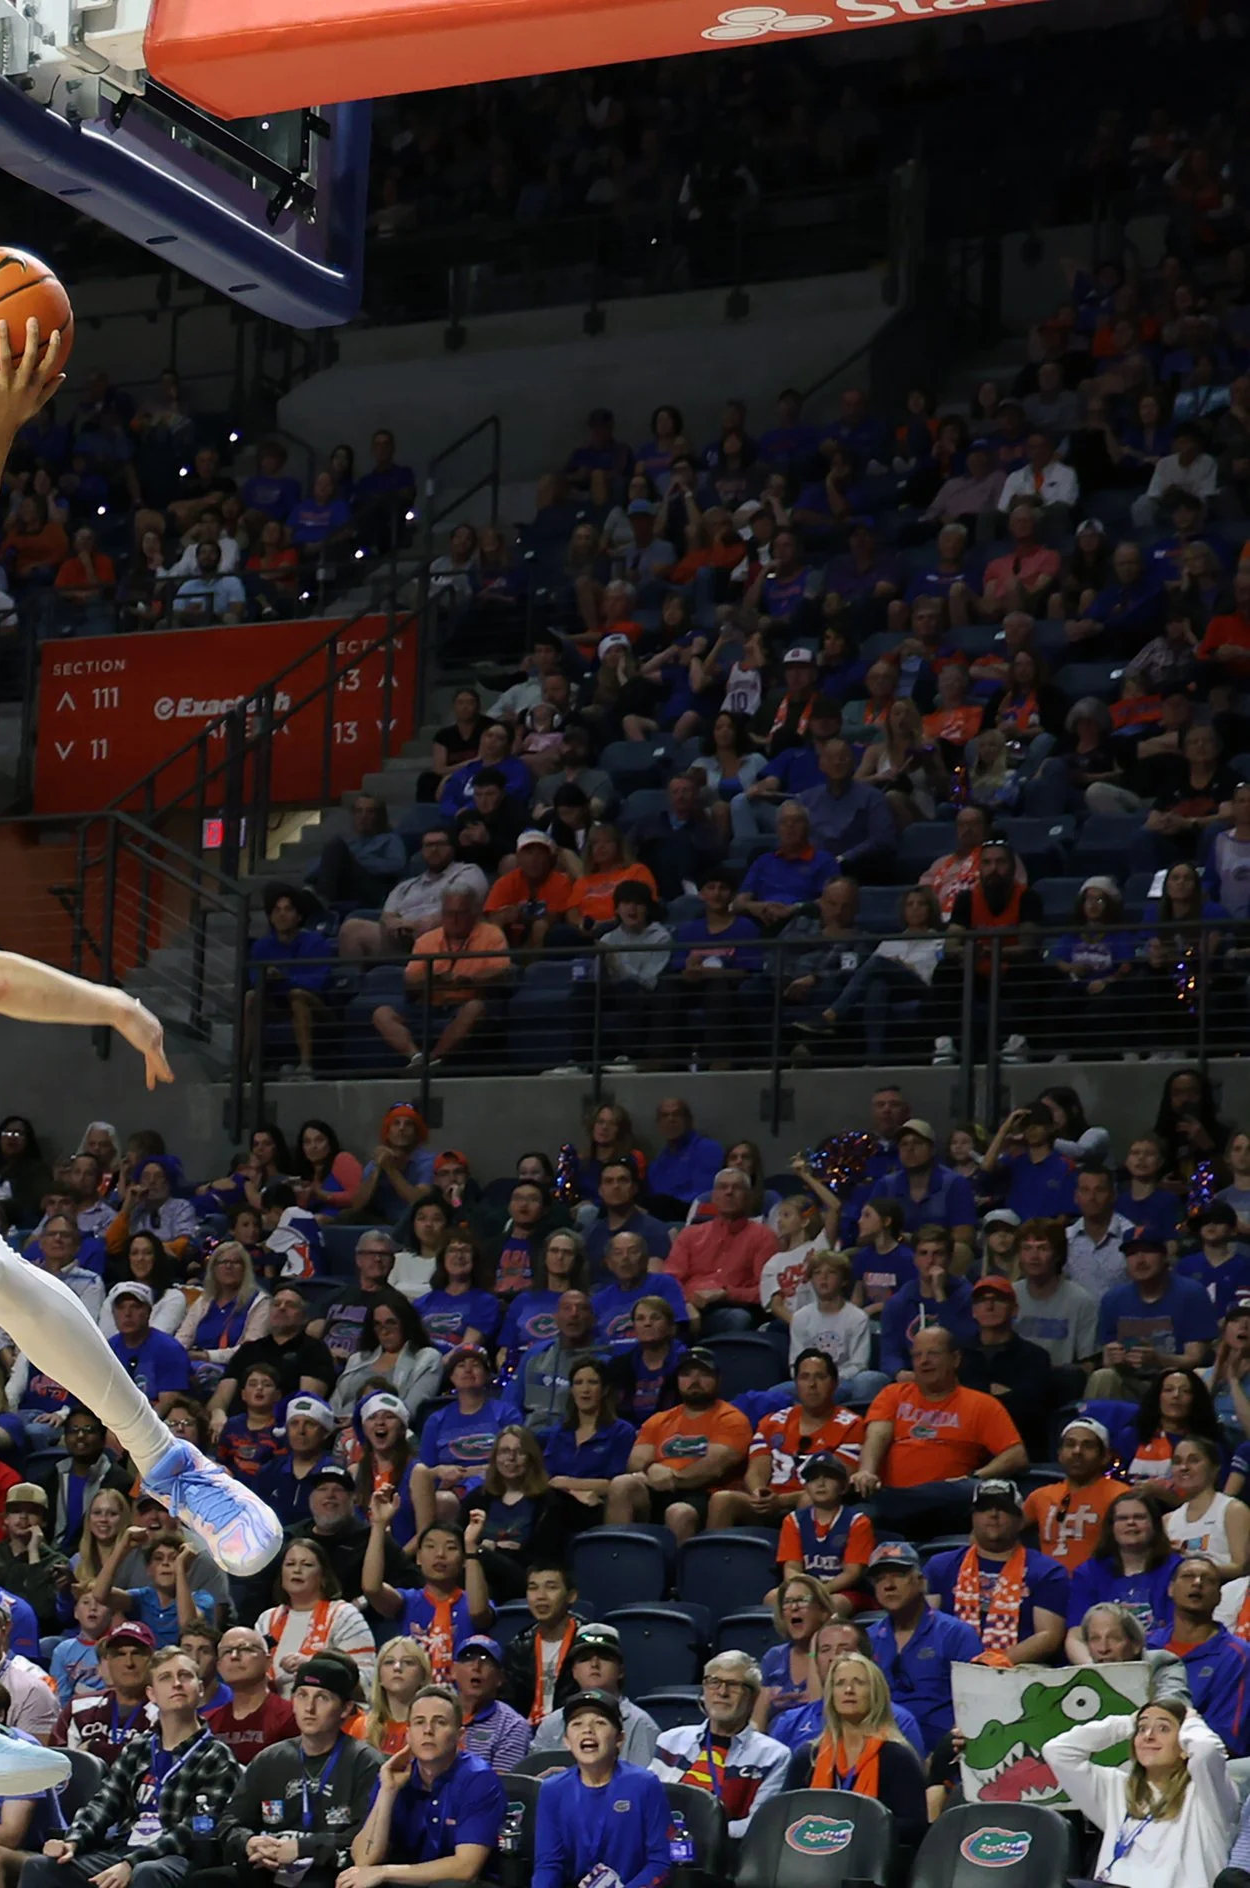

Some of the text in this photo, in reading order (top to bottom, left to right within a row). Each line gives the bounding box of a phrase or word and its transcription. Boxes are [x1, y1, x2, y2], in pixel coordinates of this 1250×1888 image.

[53, 659, 126, 676] SECTION
[92, 687, 119, 709] 111
[333, 721, 358, 744] 13
[90, 738, 108, 760] 11
[895, 1401, 960, 1428] FLORIDA
